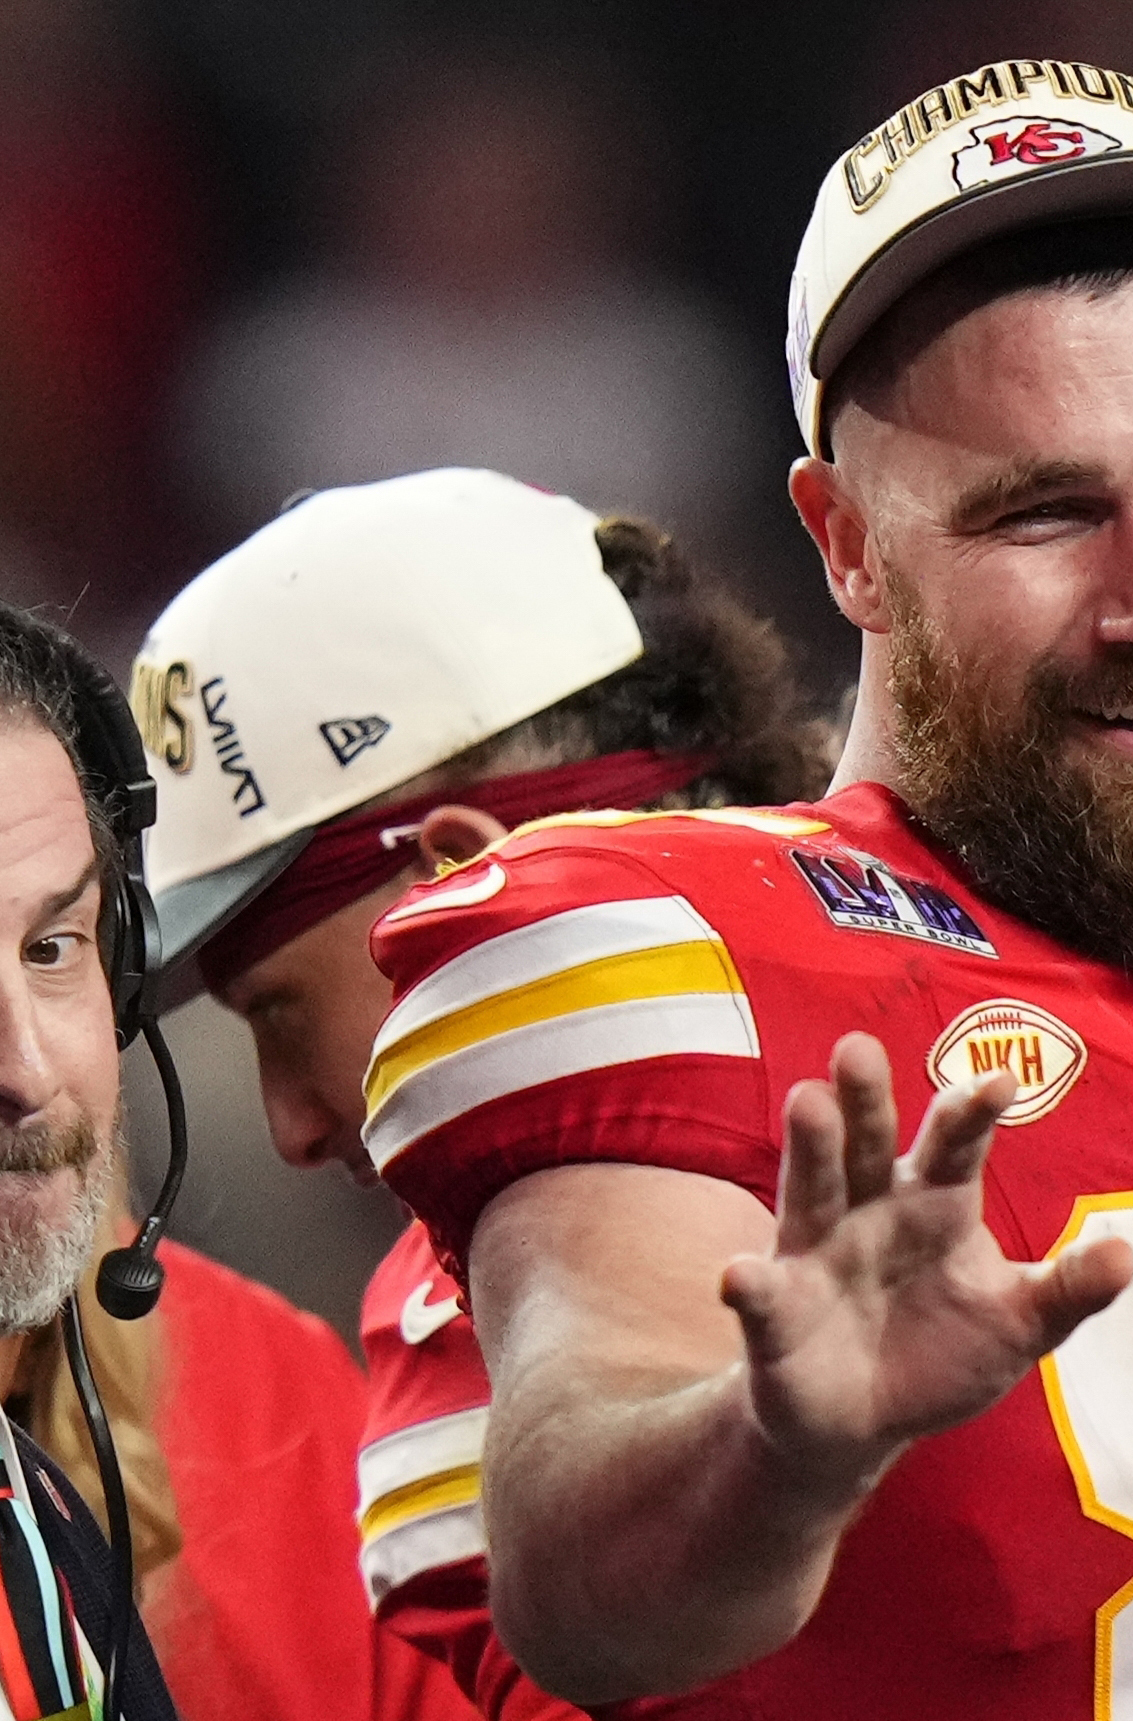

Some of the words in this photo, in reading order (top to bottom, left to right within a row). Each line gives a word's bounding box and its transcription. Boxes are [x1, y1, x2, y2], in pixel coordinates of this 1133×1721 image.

[983, 123, 1087, 167] KC
[848, 914, 916, 934] SUPER
[926, 928, 981, 950] BOWL
